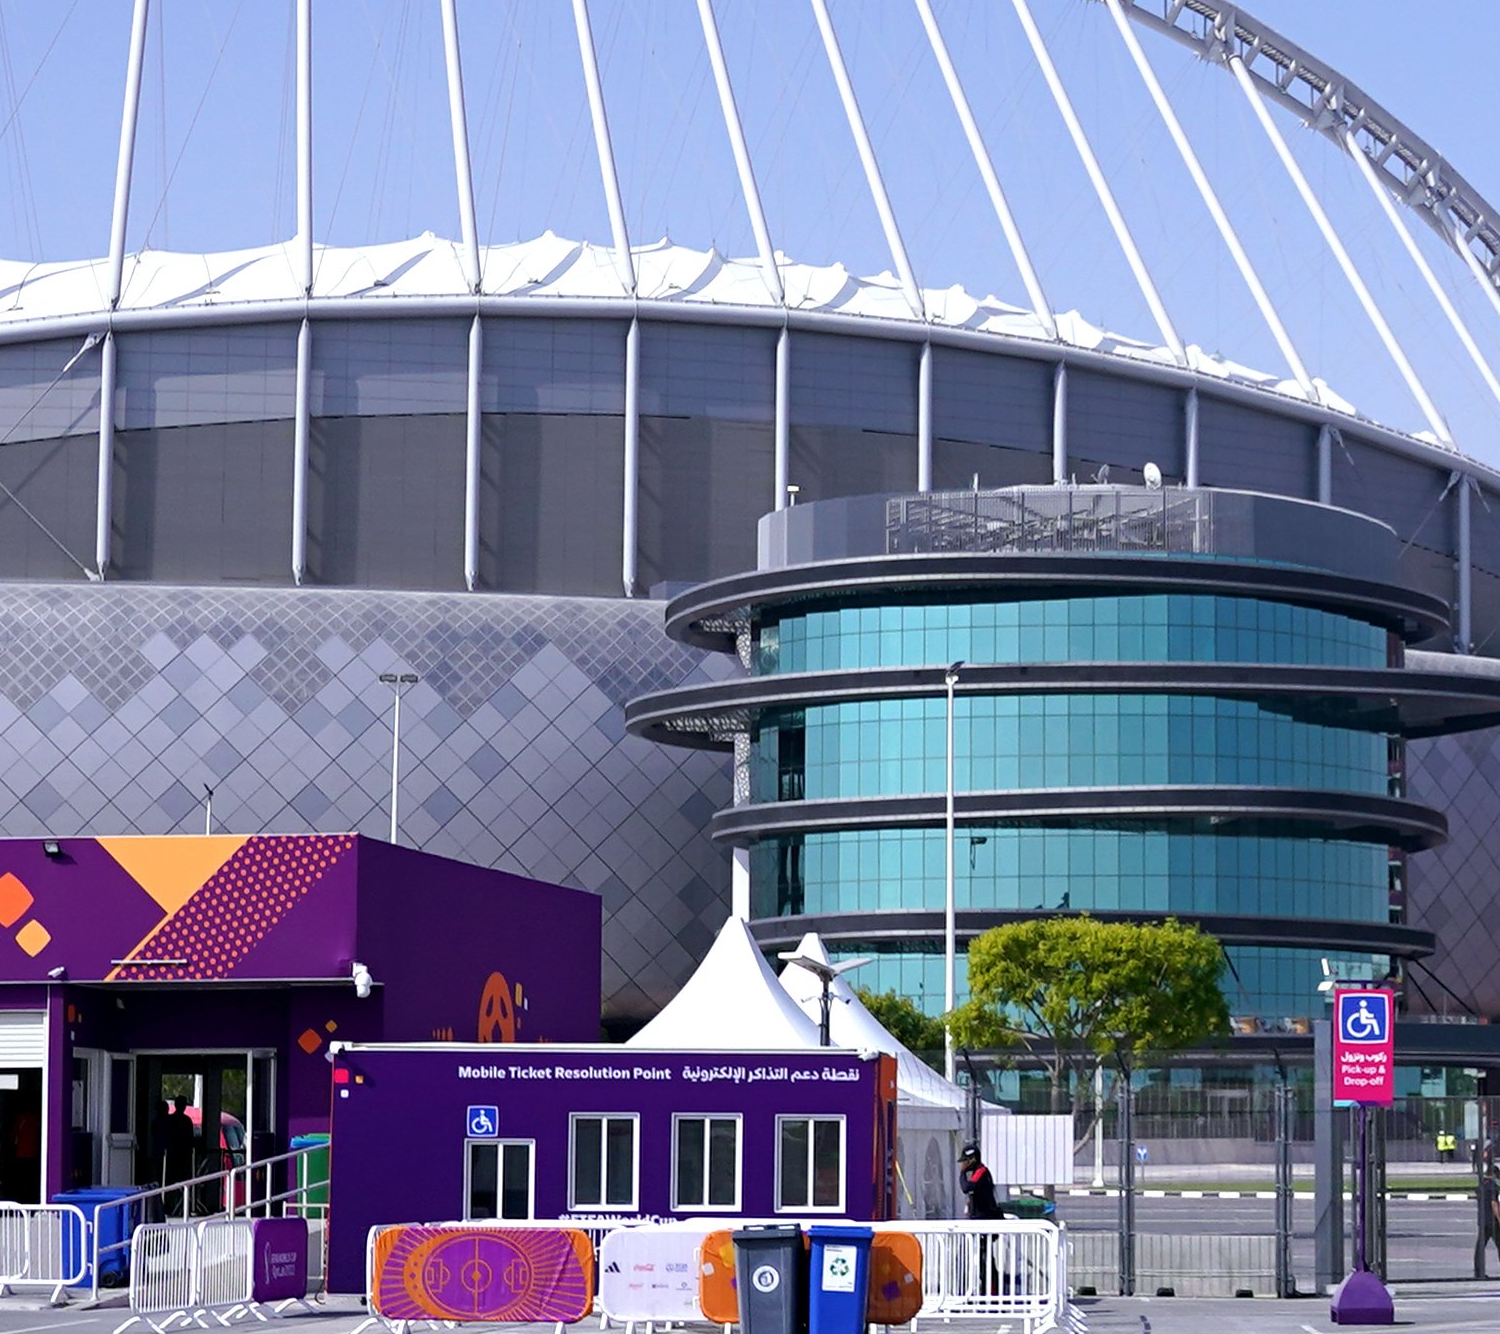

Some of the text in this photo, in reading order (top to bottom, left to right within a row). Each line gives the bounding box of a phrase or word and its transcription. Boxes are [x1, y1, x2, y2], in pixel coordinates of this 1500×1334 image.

[458, 1066, 672, 1080] Mobile Ticket Resolution Point
[682, 1066, 860, 1084] نقطة دعم التذاكر الإلكترونية
[1341, 1064, 1386, 1075] Pick-up &
[1343, 1076, 1384, 1087] Drop-off
